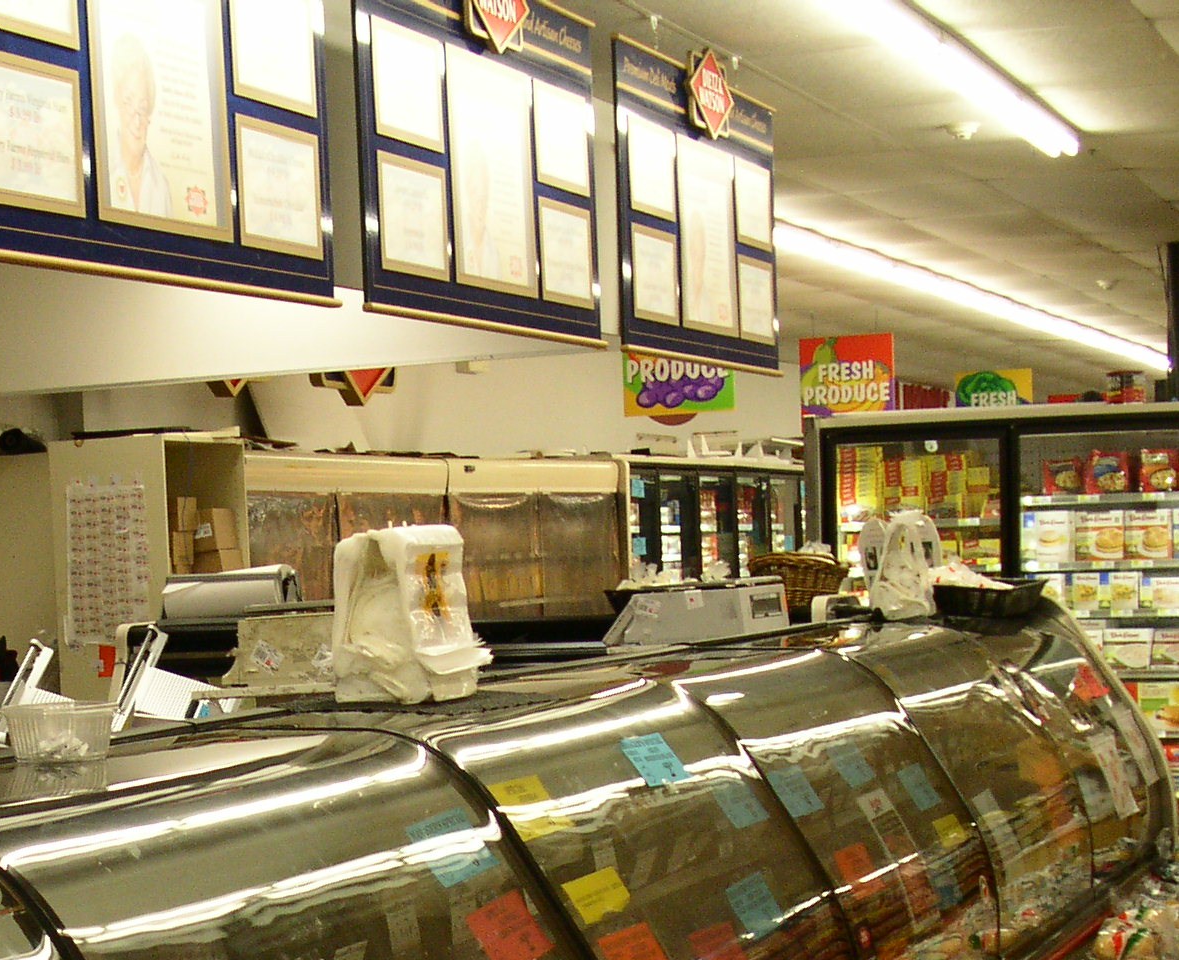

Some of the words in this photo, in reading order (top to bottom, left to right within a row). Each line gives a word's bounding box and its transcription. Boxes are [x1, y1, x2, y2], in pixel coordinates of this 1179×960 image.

[698, 86, 726, 114] WATSON
[818, 359, 874, 383] FRESH
[803, 382, 891, 406] PRODUCE
[971, 390, 1017, 407] FRESH
